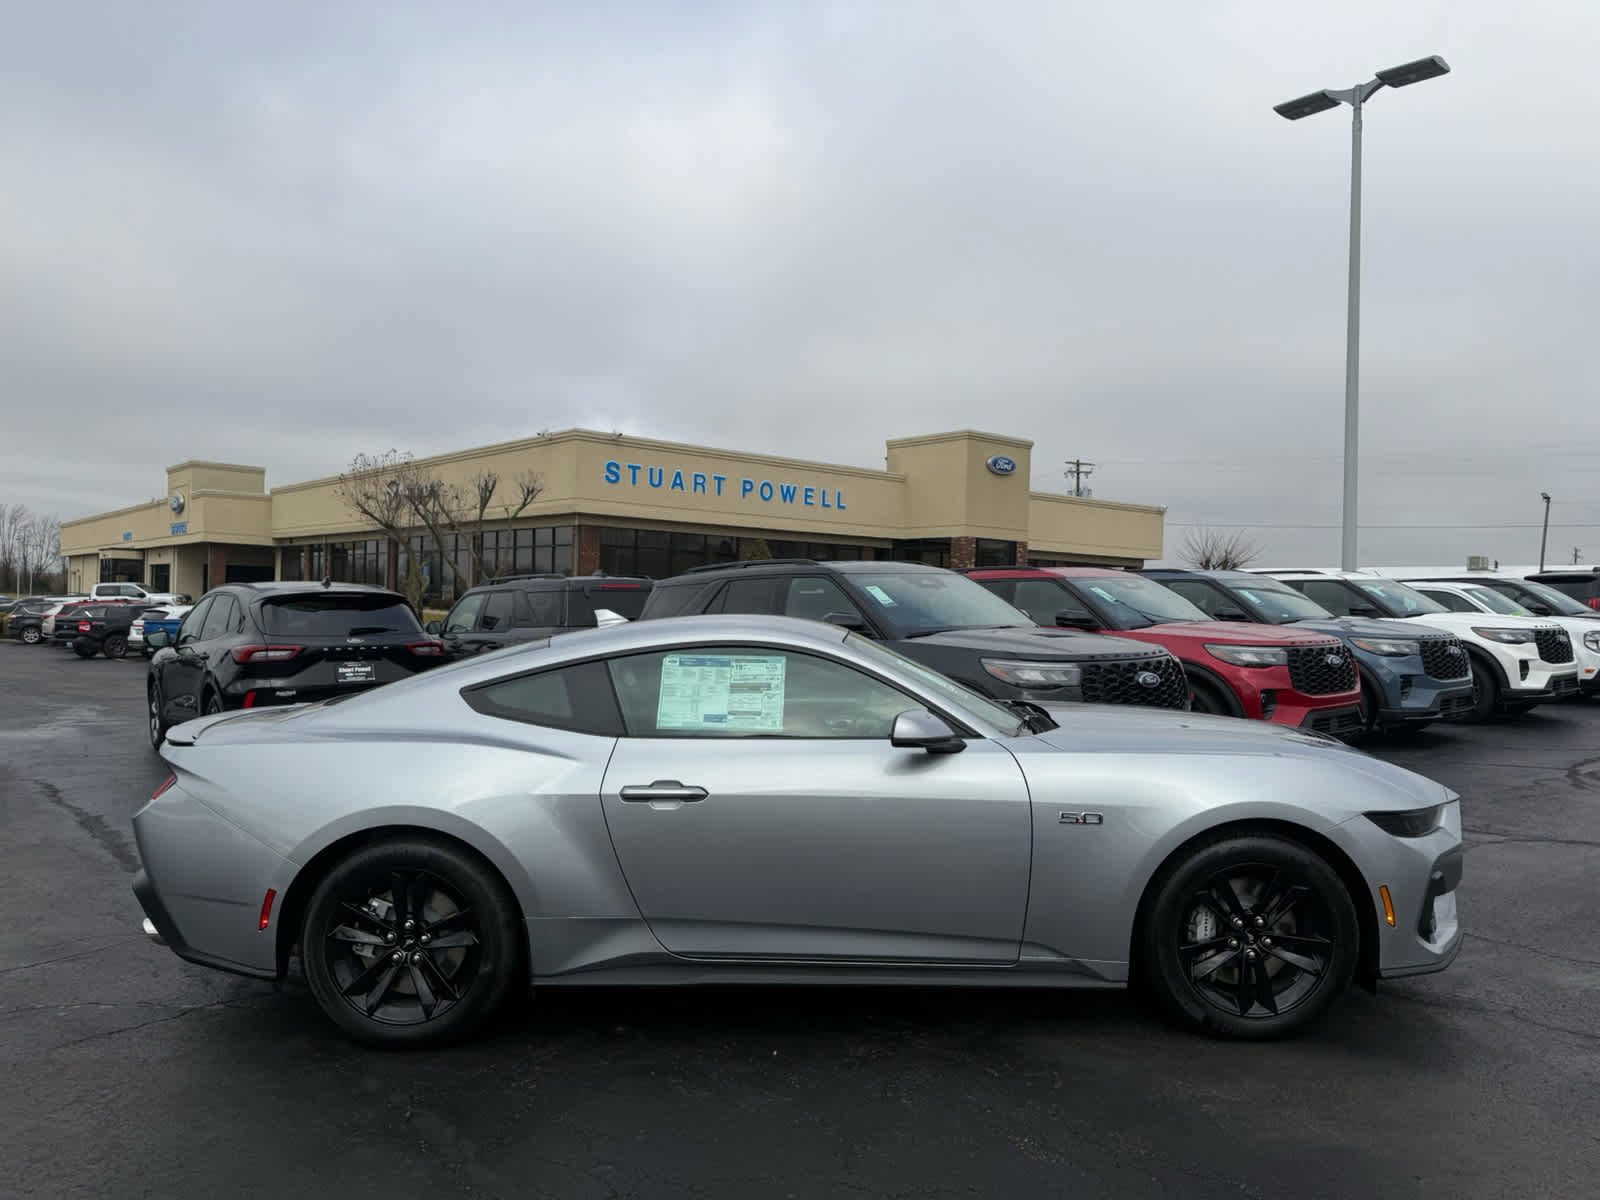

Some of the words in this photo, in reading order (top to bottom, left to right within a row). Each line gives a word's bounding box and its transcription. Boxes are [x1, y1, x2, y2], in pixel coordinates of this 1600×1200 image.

[604, 460, 726, 496] STUART
[741, 478, 847, 510] POWELL
[1059, 811, 1104, 825] 5.0
